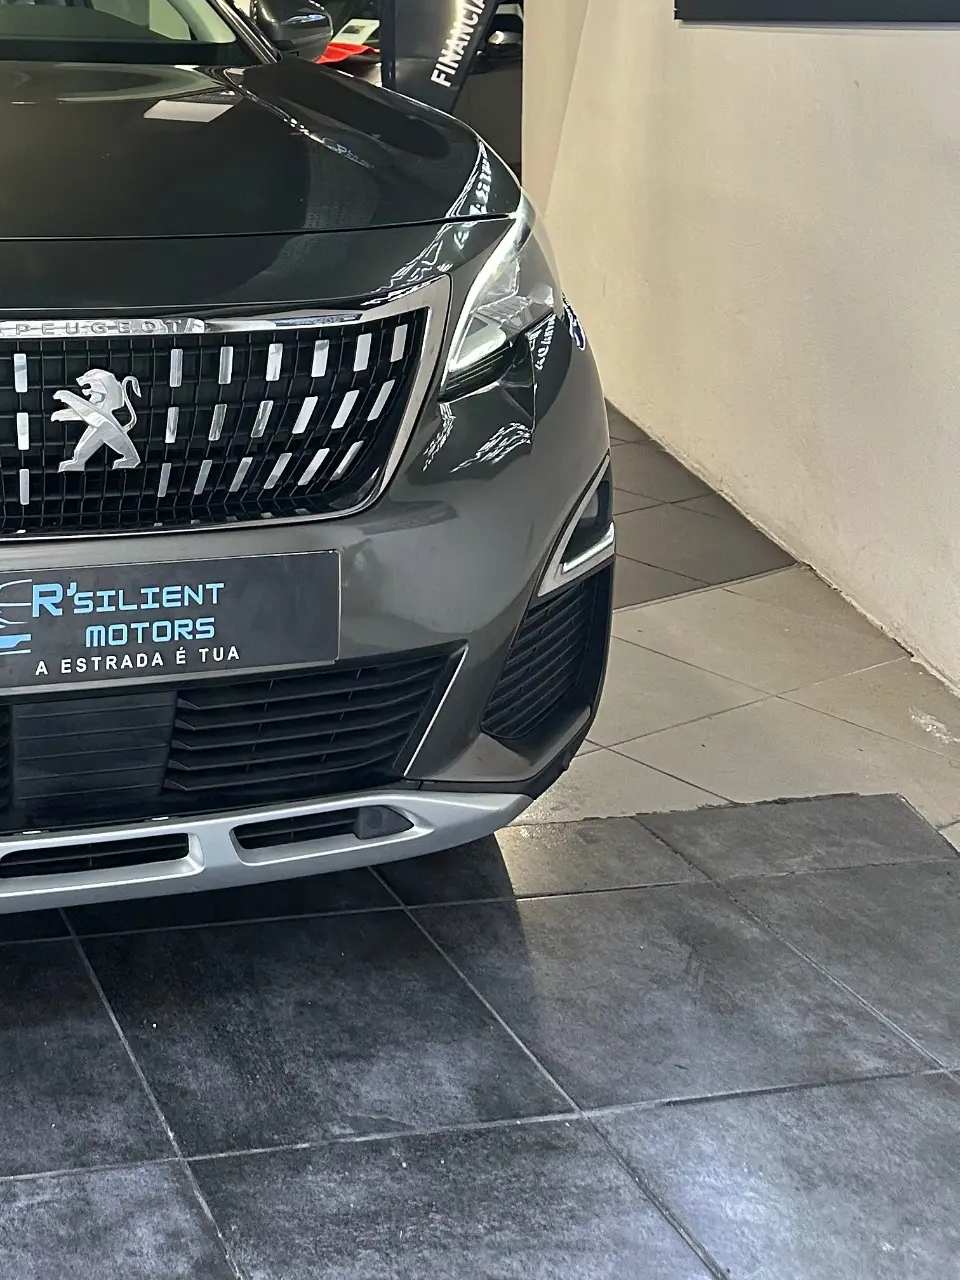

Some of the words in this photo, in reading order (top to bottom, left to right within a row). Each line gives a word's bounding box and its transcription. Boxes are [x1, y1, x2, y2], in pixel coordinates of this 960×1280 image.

[15, 320, 182, 336] PEUGEOT
[32, 582, 224, 618] R'SILIENT
[85, 617, 215, 648] MOTORS
[35, 661, 49, 675] A
[61, 652, 164, 674] ESTRADA
[176, 646, 187, 665] É
[198, 645, 241, 663] TUA
